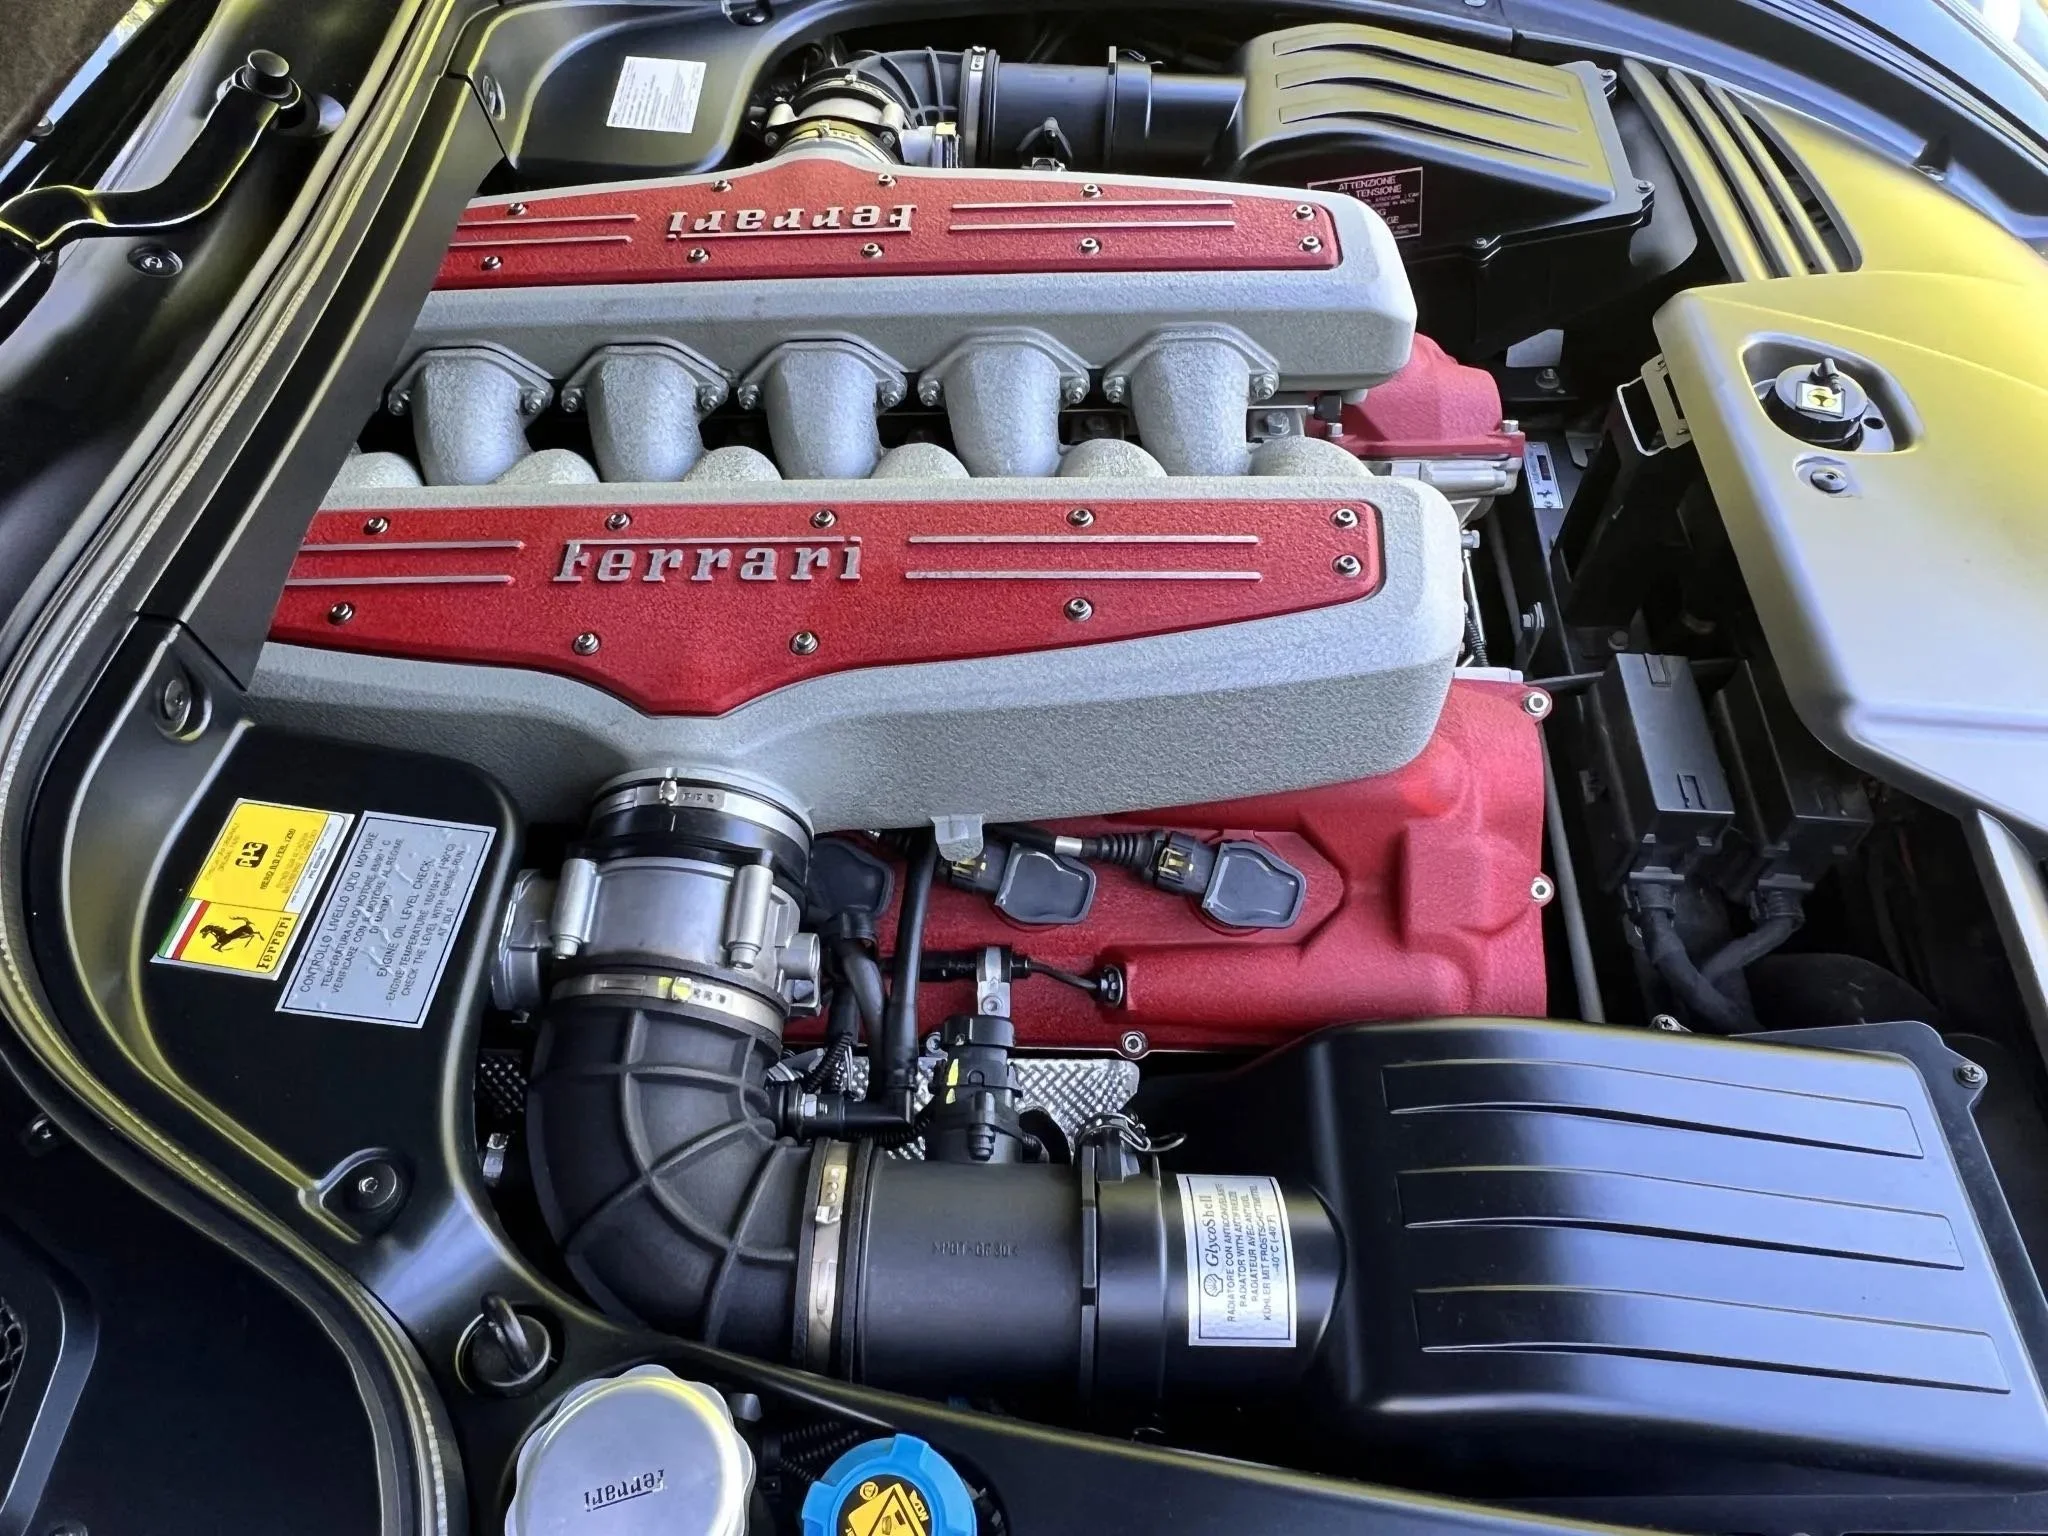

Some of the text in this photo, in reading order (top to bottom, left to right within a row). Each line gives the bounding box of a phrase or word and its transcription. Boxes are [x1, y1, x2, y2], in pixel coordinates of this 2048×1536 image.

[1339, 176, 1396, 191] ATTENZIONE
[1356, 184, 1402, 198] TENSIONE
[667, 204, 918, 240] Ferrari
[553, 536, 863, 583] Ferrari
[235, 841, 267, 867] PPG
[299, 831, 379, 992] CONTROLLO LIVELLO OLIO MOTORE
[321, 929, 353, 987] TEMPERATURA
[355, 874, 377, 906] MOTORE
[377, 860, 433, 977] ENGINE OIL LEVEL CHECK
[399, 909, 430, 965] TEMPERATURE
[256, 916, 293, 969] Ferrari
[332, 946, 359, 993] VERIFICARE
[353, 924, 368, 942] CON
[401, 968, 420, 995] CHECK
[413, 947, 428, 964] THE
[421, 922, 438, 945] LEVEL
[431, 899, 447, 918] WITH
[1199, 1195, 1221, 1266] GlycoShell
[1225, 1246, 1234, 1266] CON
[1235, 1235, 1244, 1256] WITH
[1246, 1225, 1255, 1246] AVEC
[1226, 1269, 1236, 1322] RADIATORE
[1237, 1259, 1248, 1307] RADIATOR
[1248, 1249, 1258, 1302] RADIATEUR
